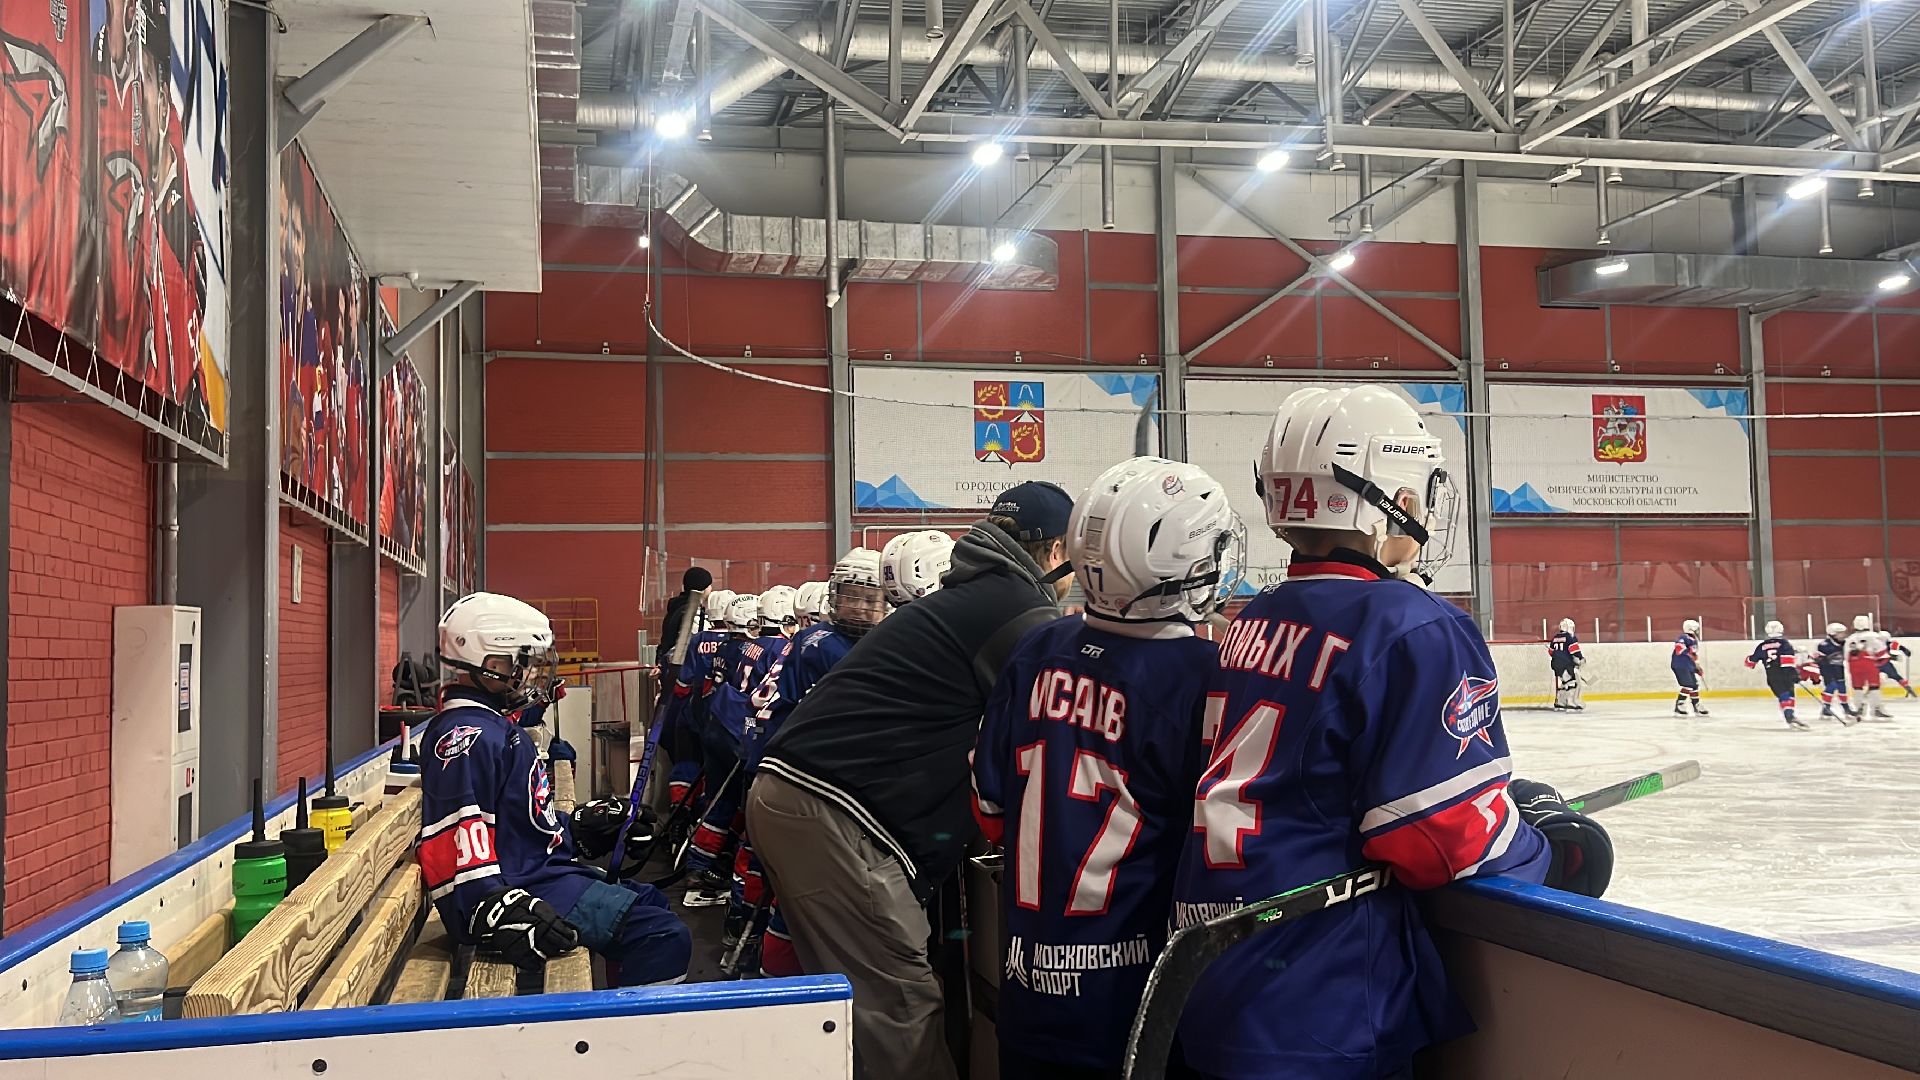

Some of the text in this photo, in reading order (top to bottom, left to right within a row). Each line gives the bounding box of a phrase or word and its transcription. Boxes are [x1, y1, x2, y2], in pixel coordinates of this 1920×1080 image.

[1547, 484, 1699, 495] ФИЗИЧЕСКОЙ КУЛЬТУРЫ И СПОРТА
[1587, 474, 1659, 483] МИНИСТЕРСТВО
[1273, 477, 1318, 520] 74
[1572, 497, 1677, 507] МОСКОВСКОЙ ОБЛАСТИ
[1084, 565, 1103, 592] 17
[1015, 739, 1144, 917] 17
[454, 820, 490, 867] 90
[1033, 933, 1150, 970] МОСКОВСКИЙ
[1031, 968, 1082, 997] СПОРТ
